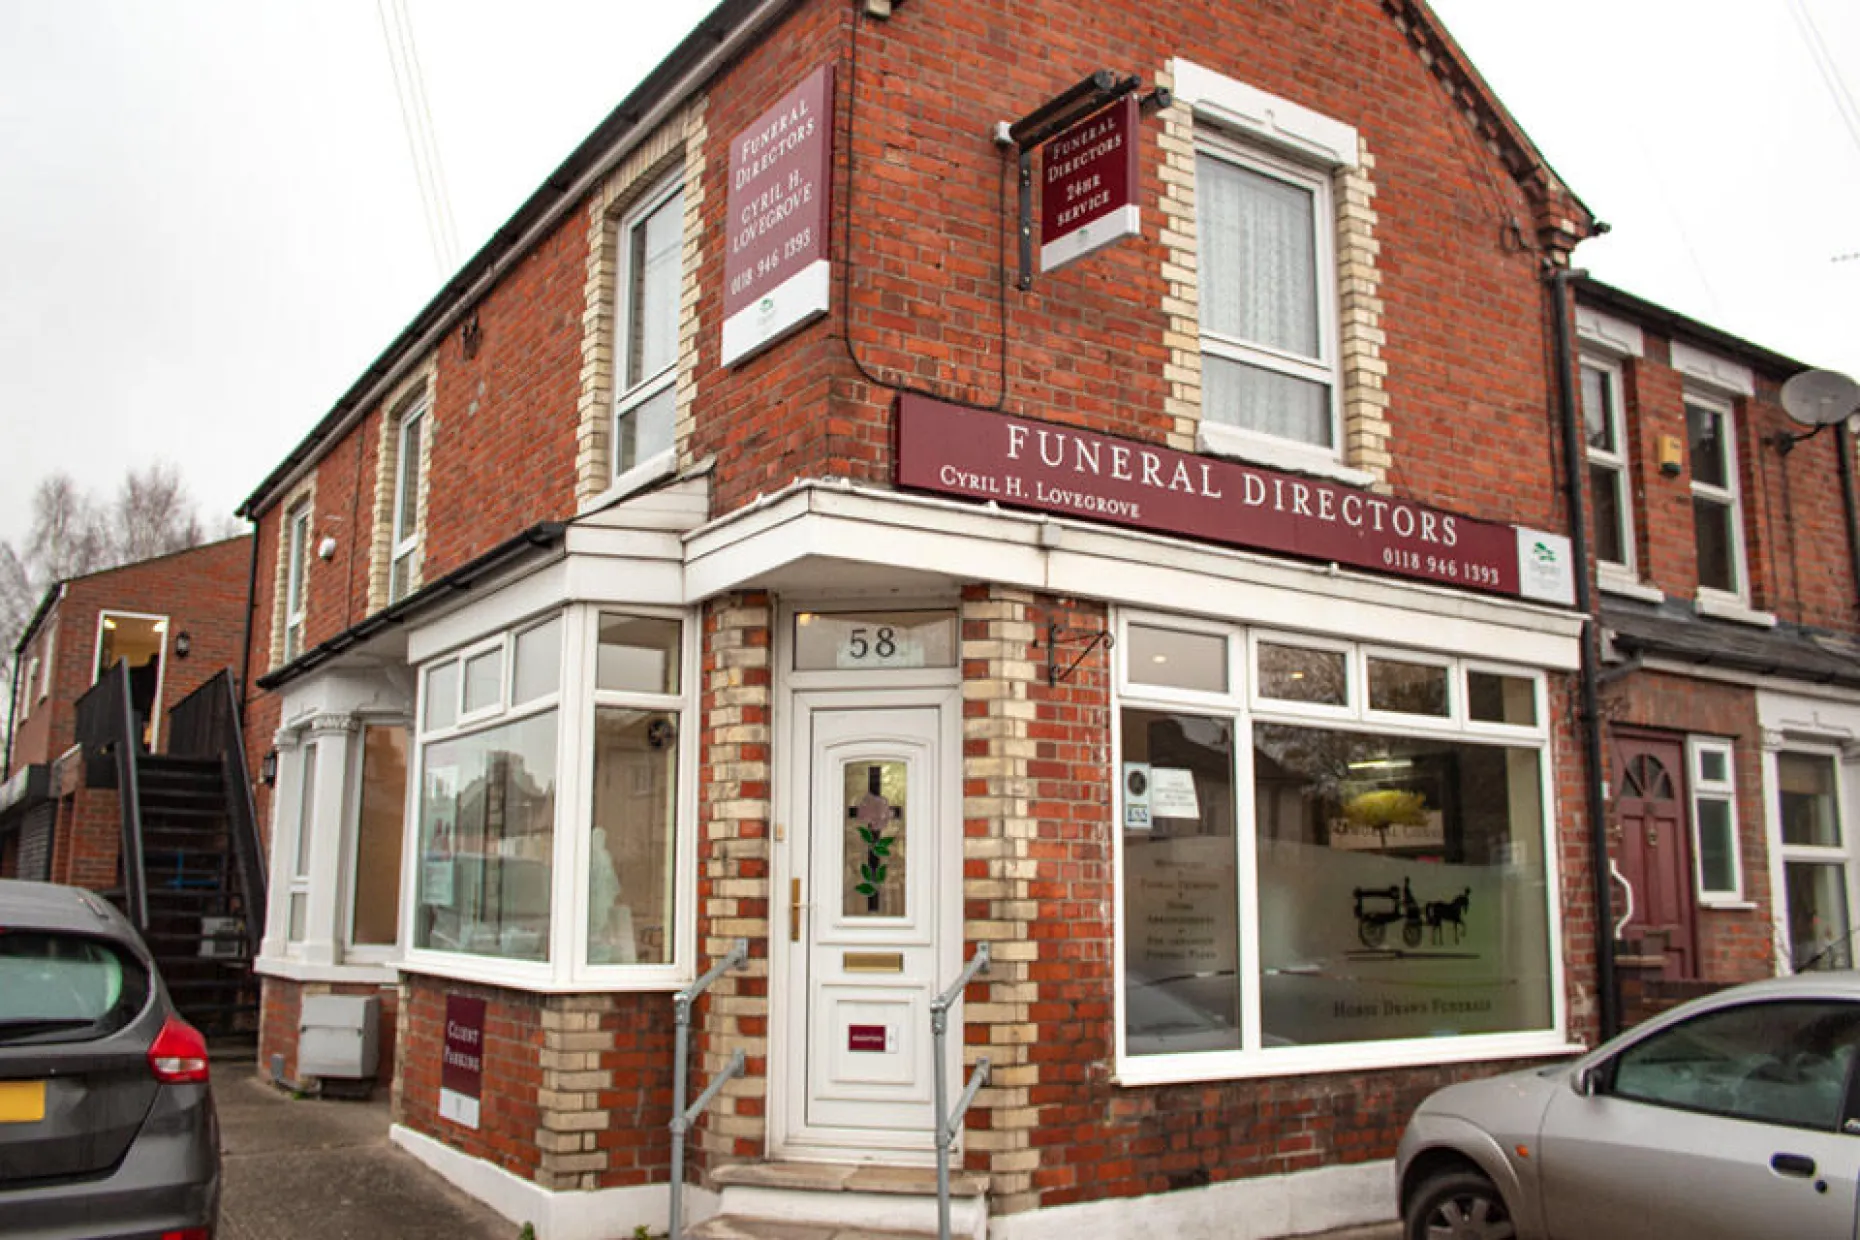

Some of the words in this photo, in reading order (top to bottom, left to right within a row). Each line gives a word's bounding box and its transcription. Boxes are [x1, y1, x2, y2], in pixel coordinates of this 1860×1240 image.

[735, 117, 815, 191] DIRECTORS
[741, 98, 809, 164] FUNERAL
[1053, 117, 1116, 160] FUNERAL
[1048, 134, 1123, 183] DIRECTORS
[733, 183, 813, 253] LOVEGROVE
[741, 182, 784, 224] CYRIL
[1057, 190, 1111, 227] SERVICE
[730, 267, 753, 295] 0118
[757, 252, 779, 279] 946
[784, 227, 811, 260] 1393
[940, 464, 1000, 493] CYRIL
[1006, 476, 1029, 498] H.
[1036, 482, 1140, 518] LOVEGROVE
[1006, 423, 1223, 499] FUNERAL
[1242, 473, 1458, 547] DIRECTORS
[1383, 547, 1420, 571] 0118
[1427, 555, 1458, 578] 946
[1464, 563, 1500, 586] 1393
[850, 627, 896, 659] 58
